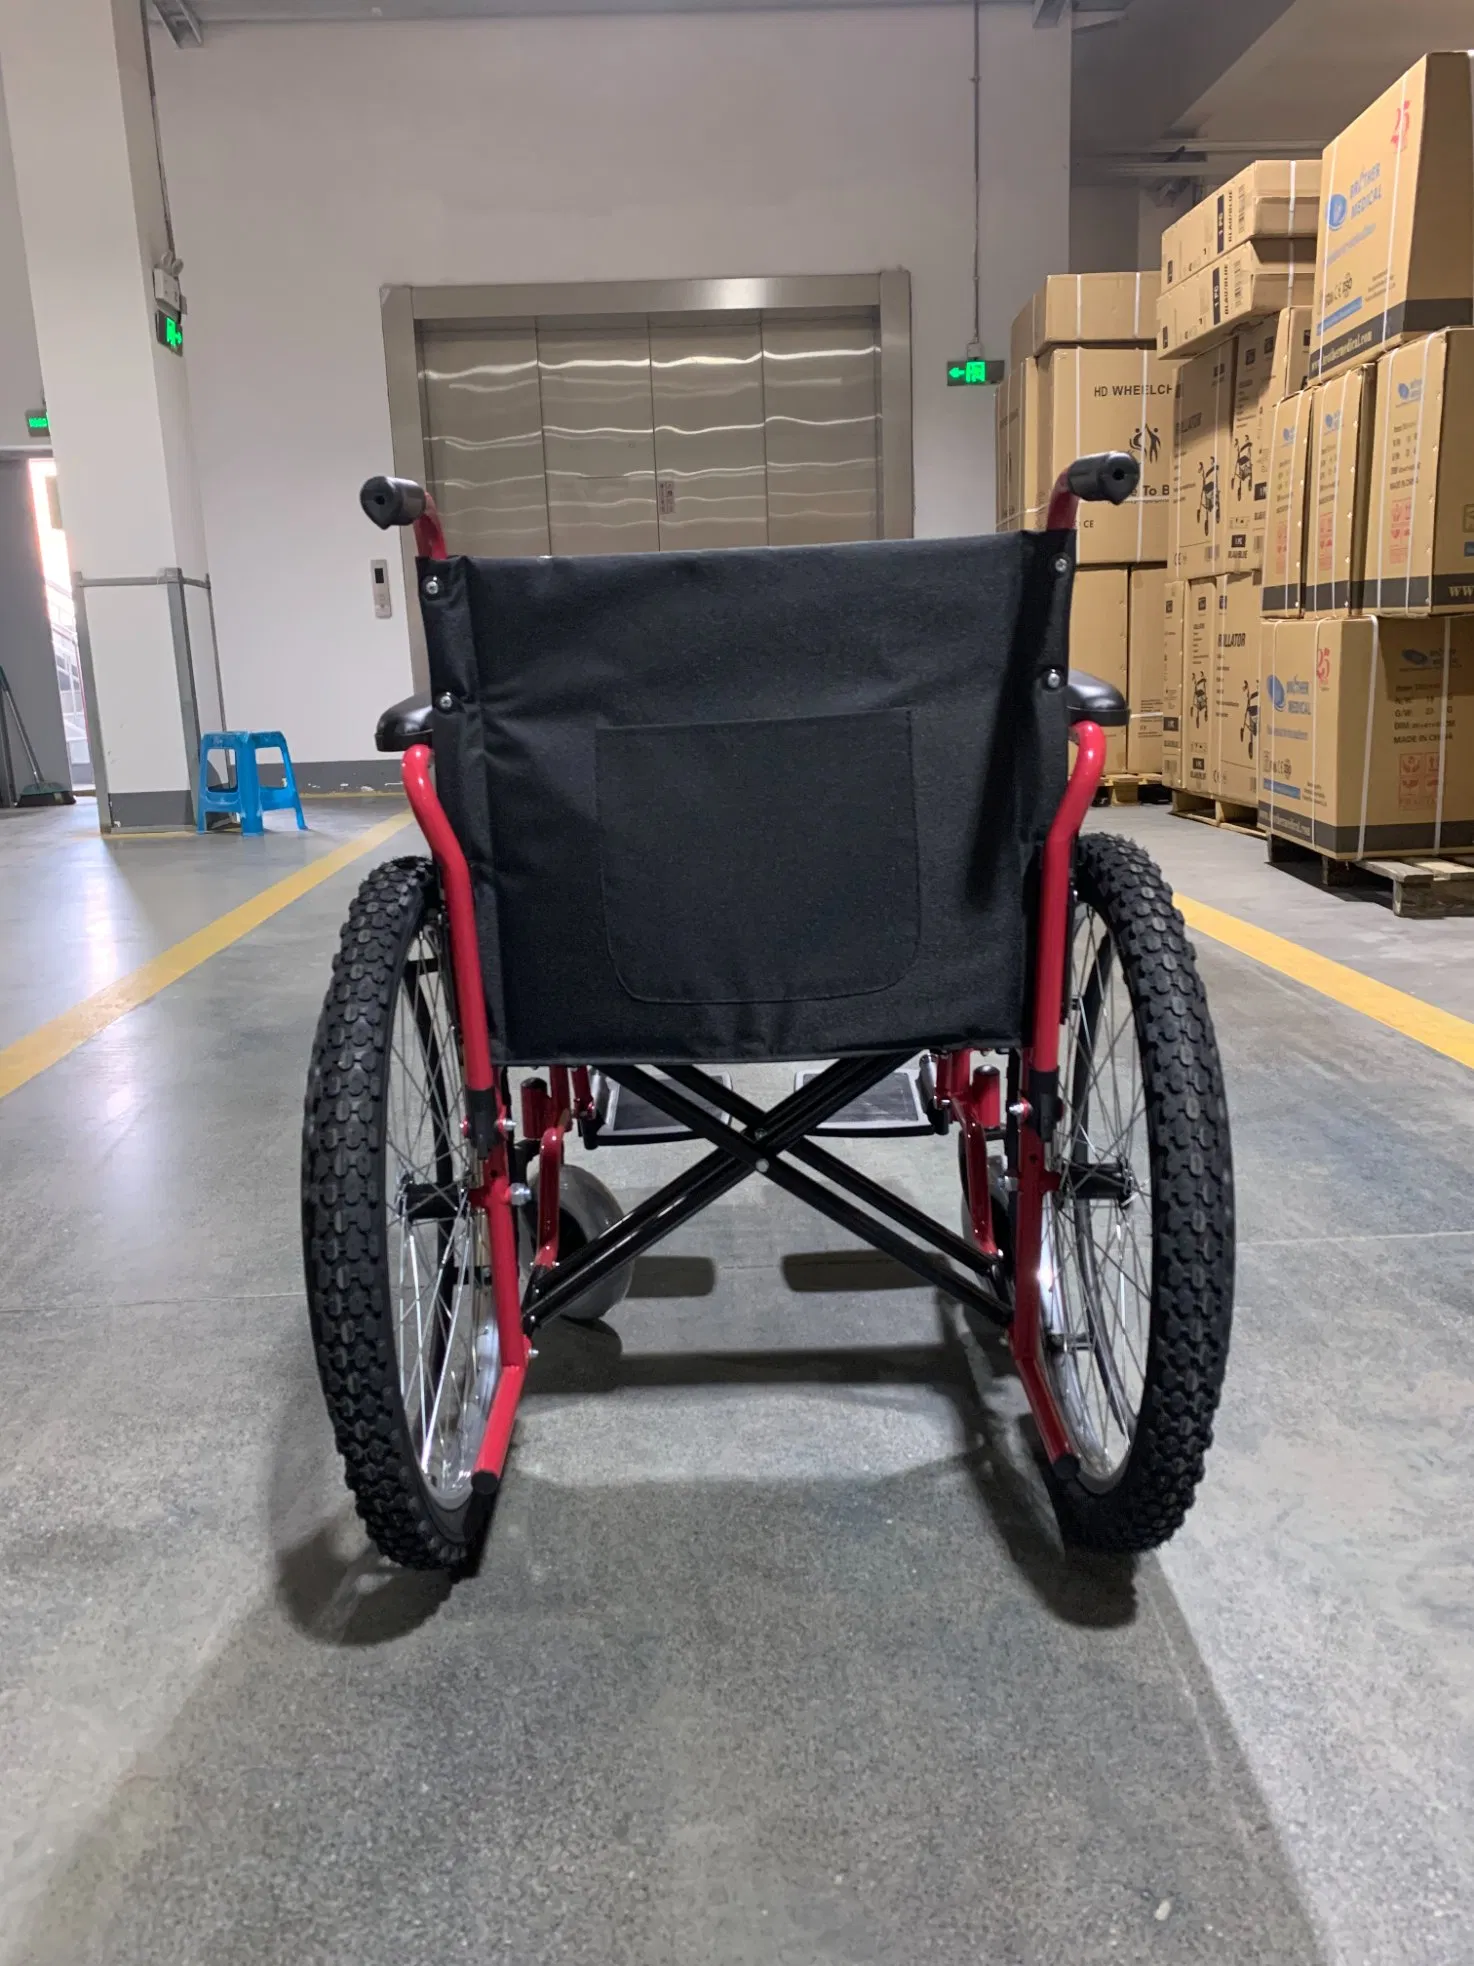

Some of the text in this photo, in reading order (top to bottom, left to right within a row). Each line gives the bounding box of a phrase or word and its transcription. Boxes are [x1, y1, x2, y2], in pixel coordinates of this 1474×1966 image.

[1094, 386, 1109, 397] HD
[1142, 485, 1158, 496] To
[1083, 520, 1095, 528] CE
[1218, 632, 1246, 648] RLLATOR
